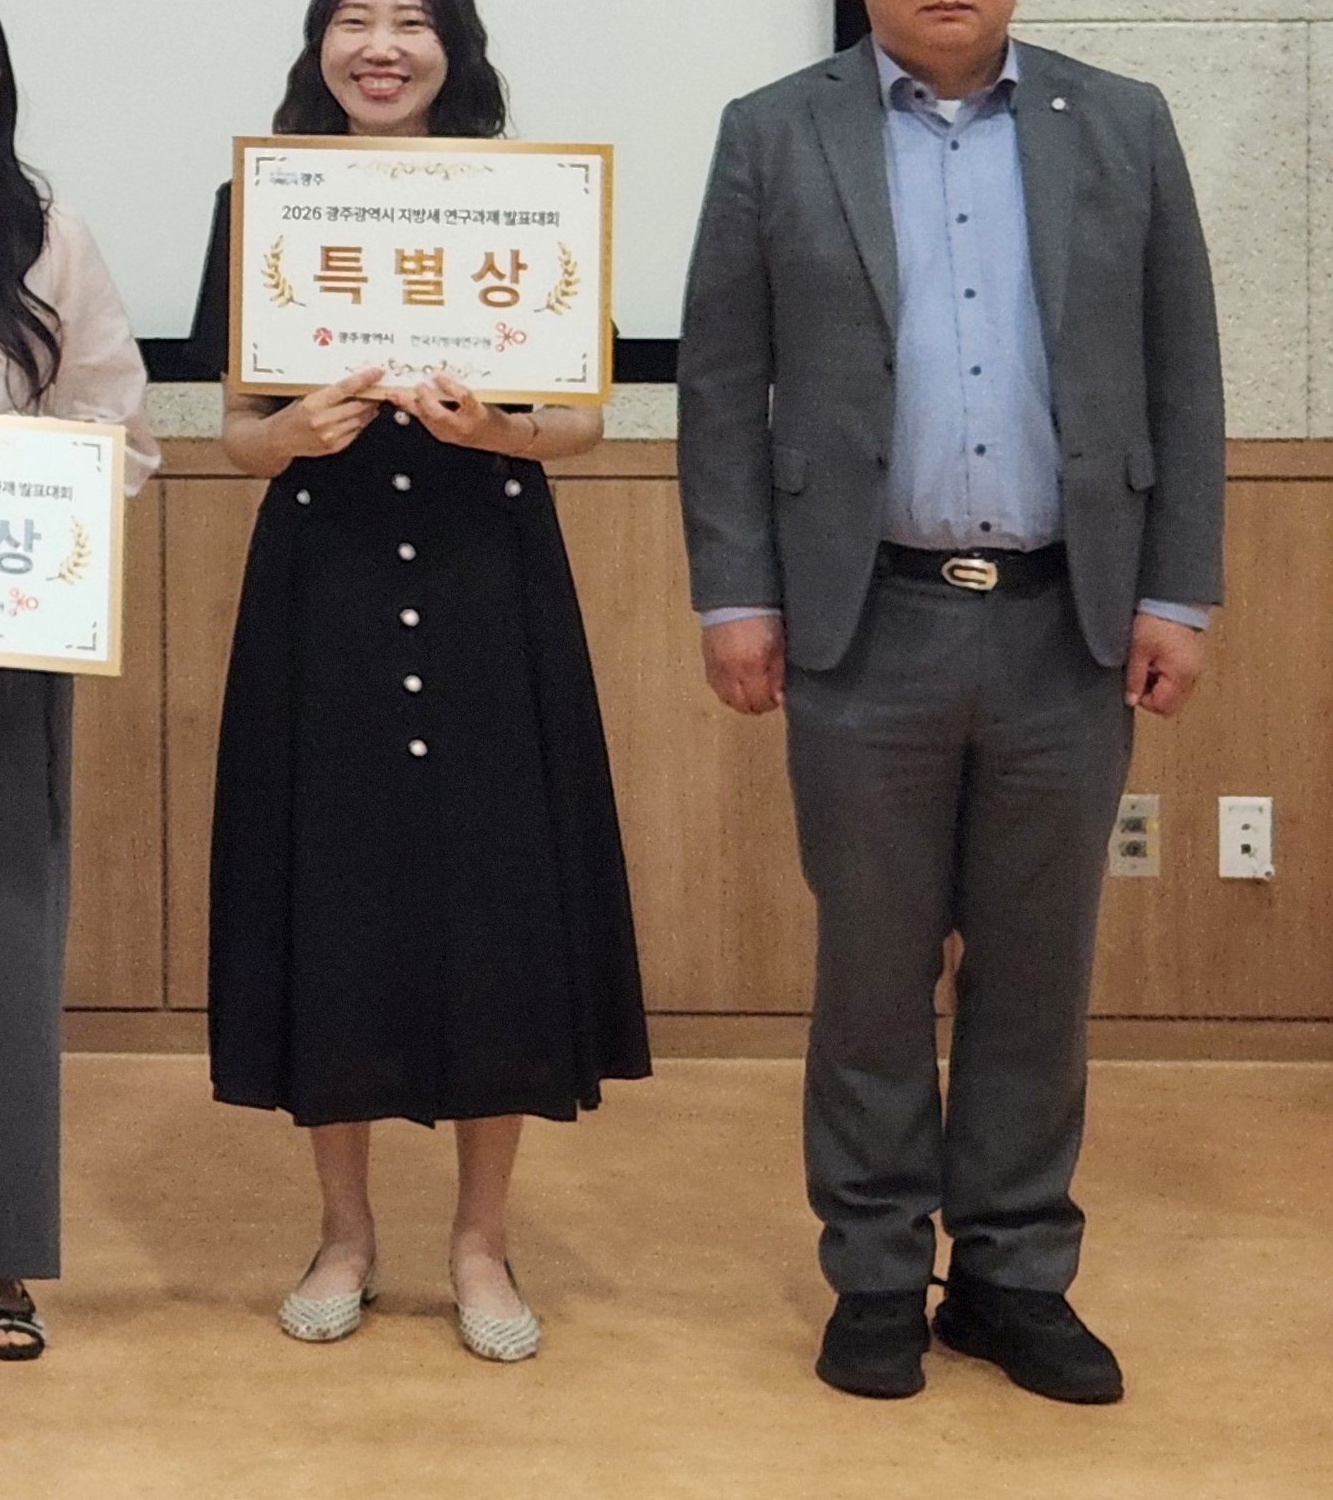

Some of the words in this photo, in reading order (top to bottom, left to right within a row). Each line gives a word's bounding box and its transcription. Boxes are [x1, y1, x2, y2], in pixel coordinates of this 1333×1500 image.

[282, 205, 322, 220] 2026
[325, 205, 394, 223] 광주광역시
[398, 206, 440, 224] 지방세
[443, 208, 500, 226] 연구과제
[503, 209, 560, 227] 발표대회
[18, 482, 73, 501] 발표대회
